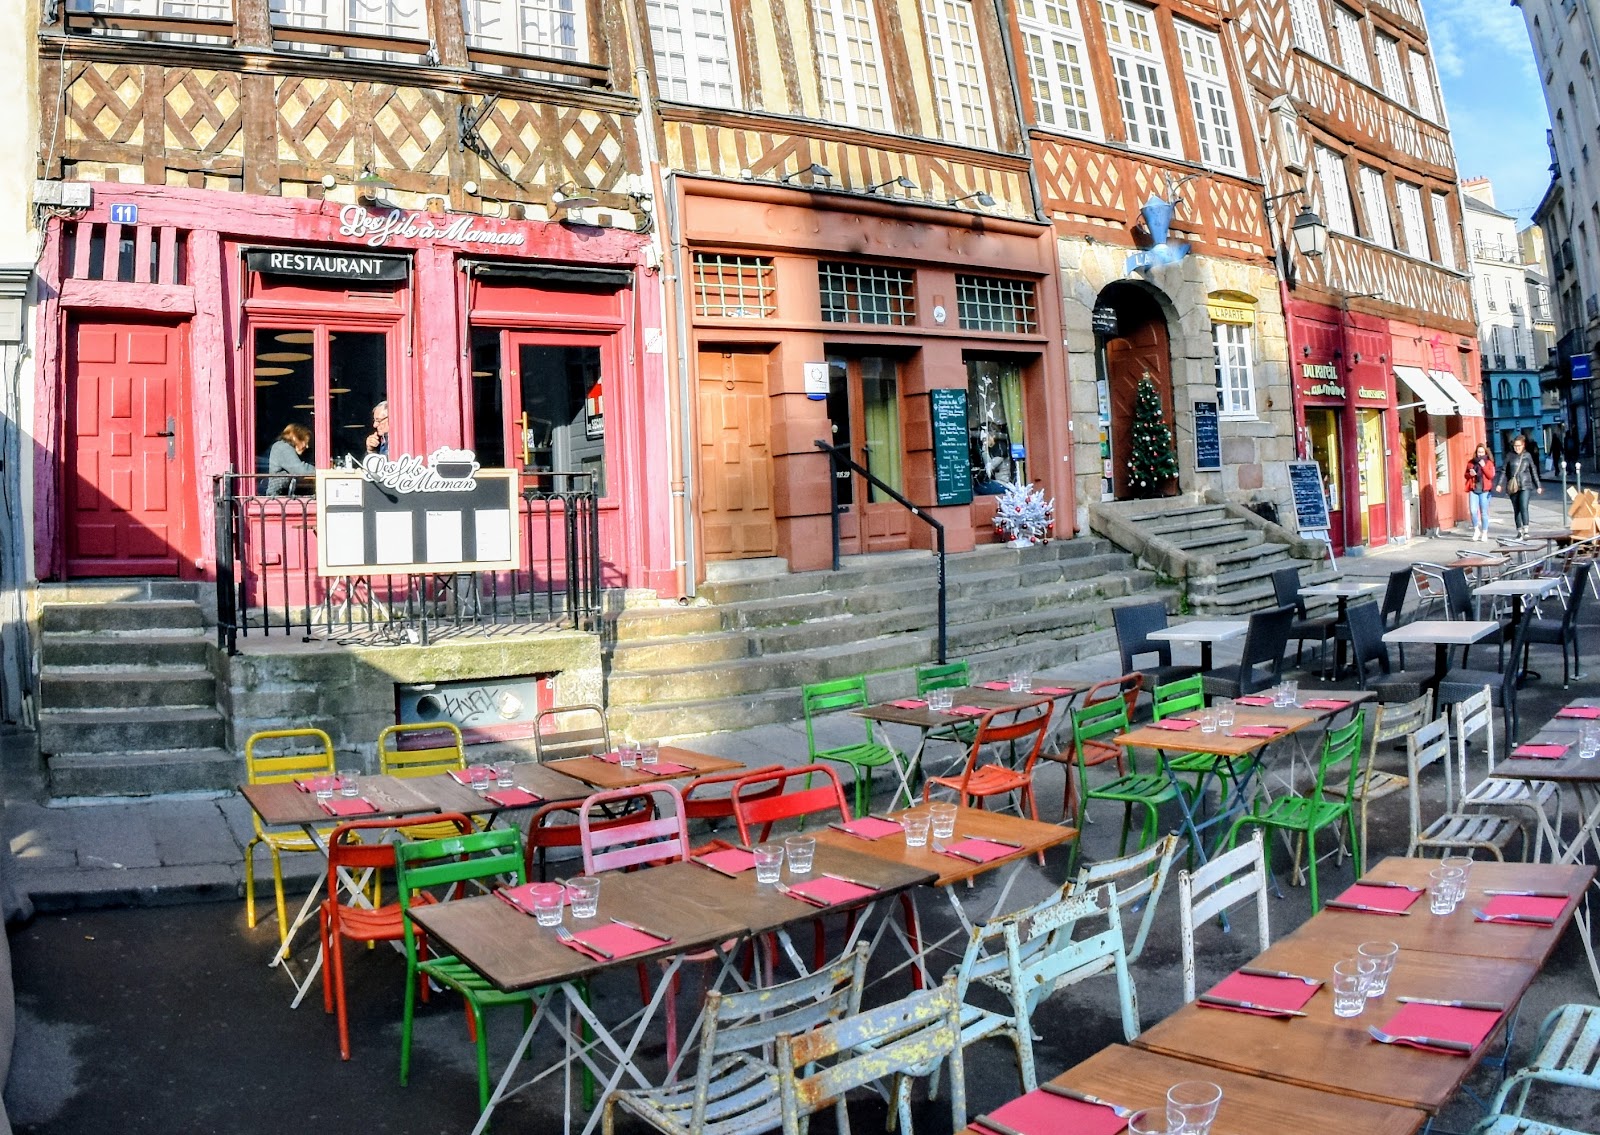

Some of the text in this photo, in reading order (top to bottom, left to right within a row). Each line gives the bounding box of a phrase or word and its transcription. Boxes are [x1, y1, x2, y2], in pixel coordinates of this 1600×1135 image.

[116, 206, 132, 222] 11
[339, 204, 525, 247] Les fils à Maman
[270, 252, 384, 275] RESTAURANT
[366, 455, 423, 486] Les fils
[411, 471, 475, 490] Maman
